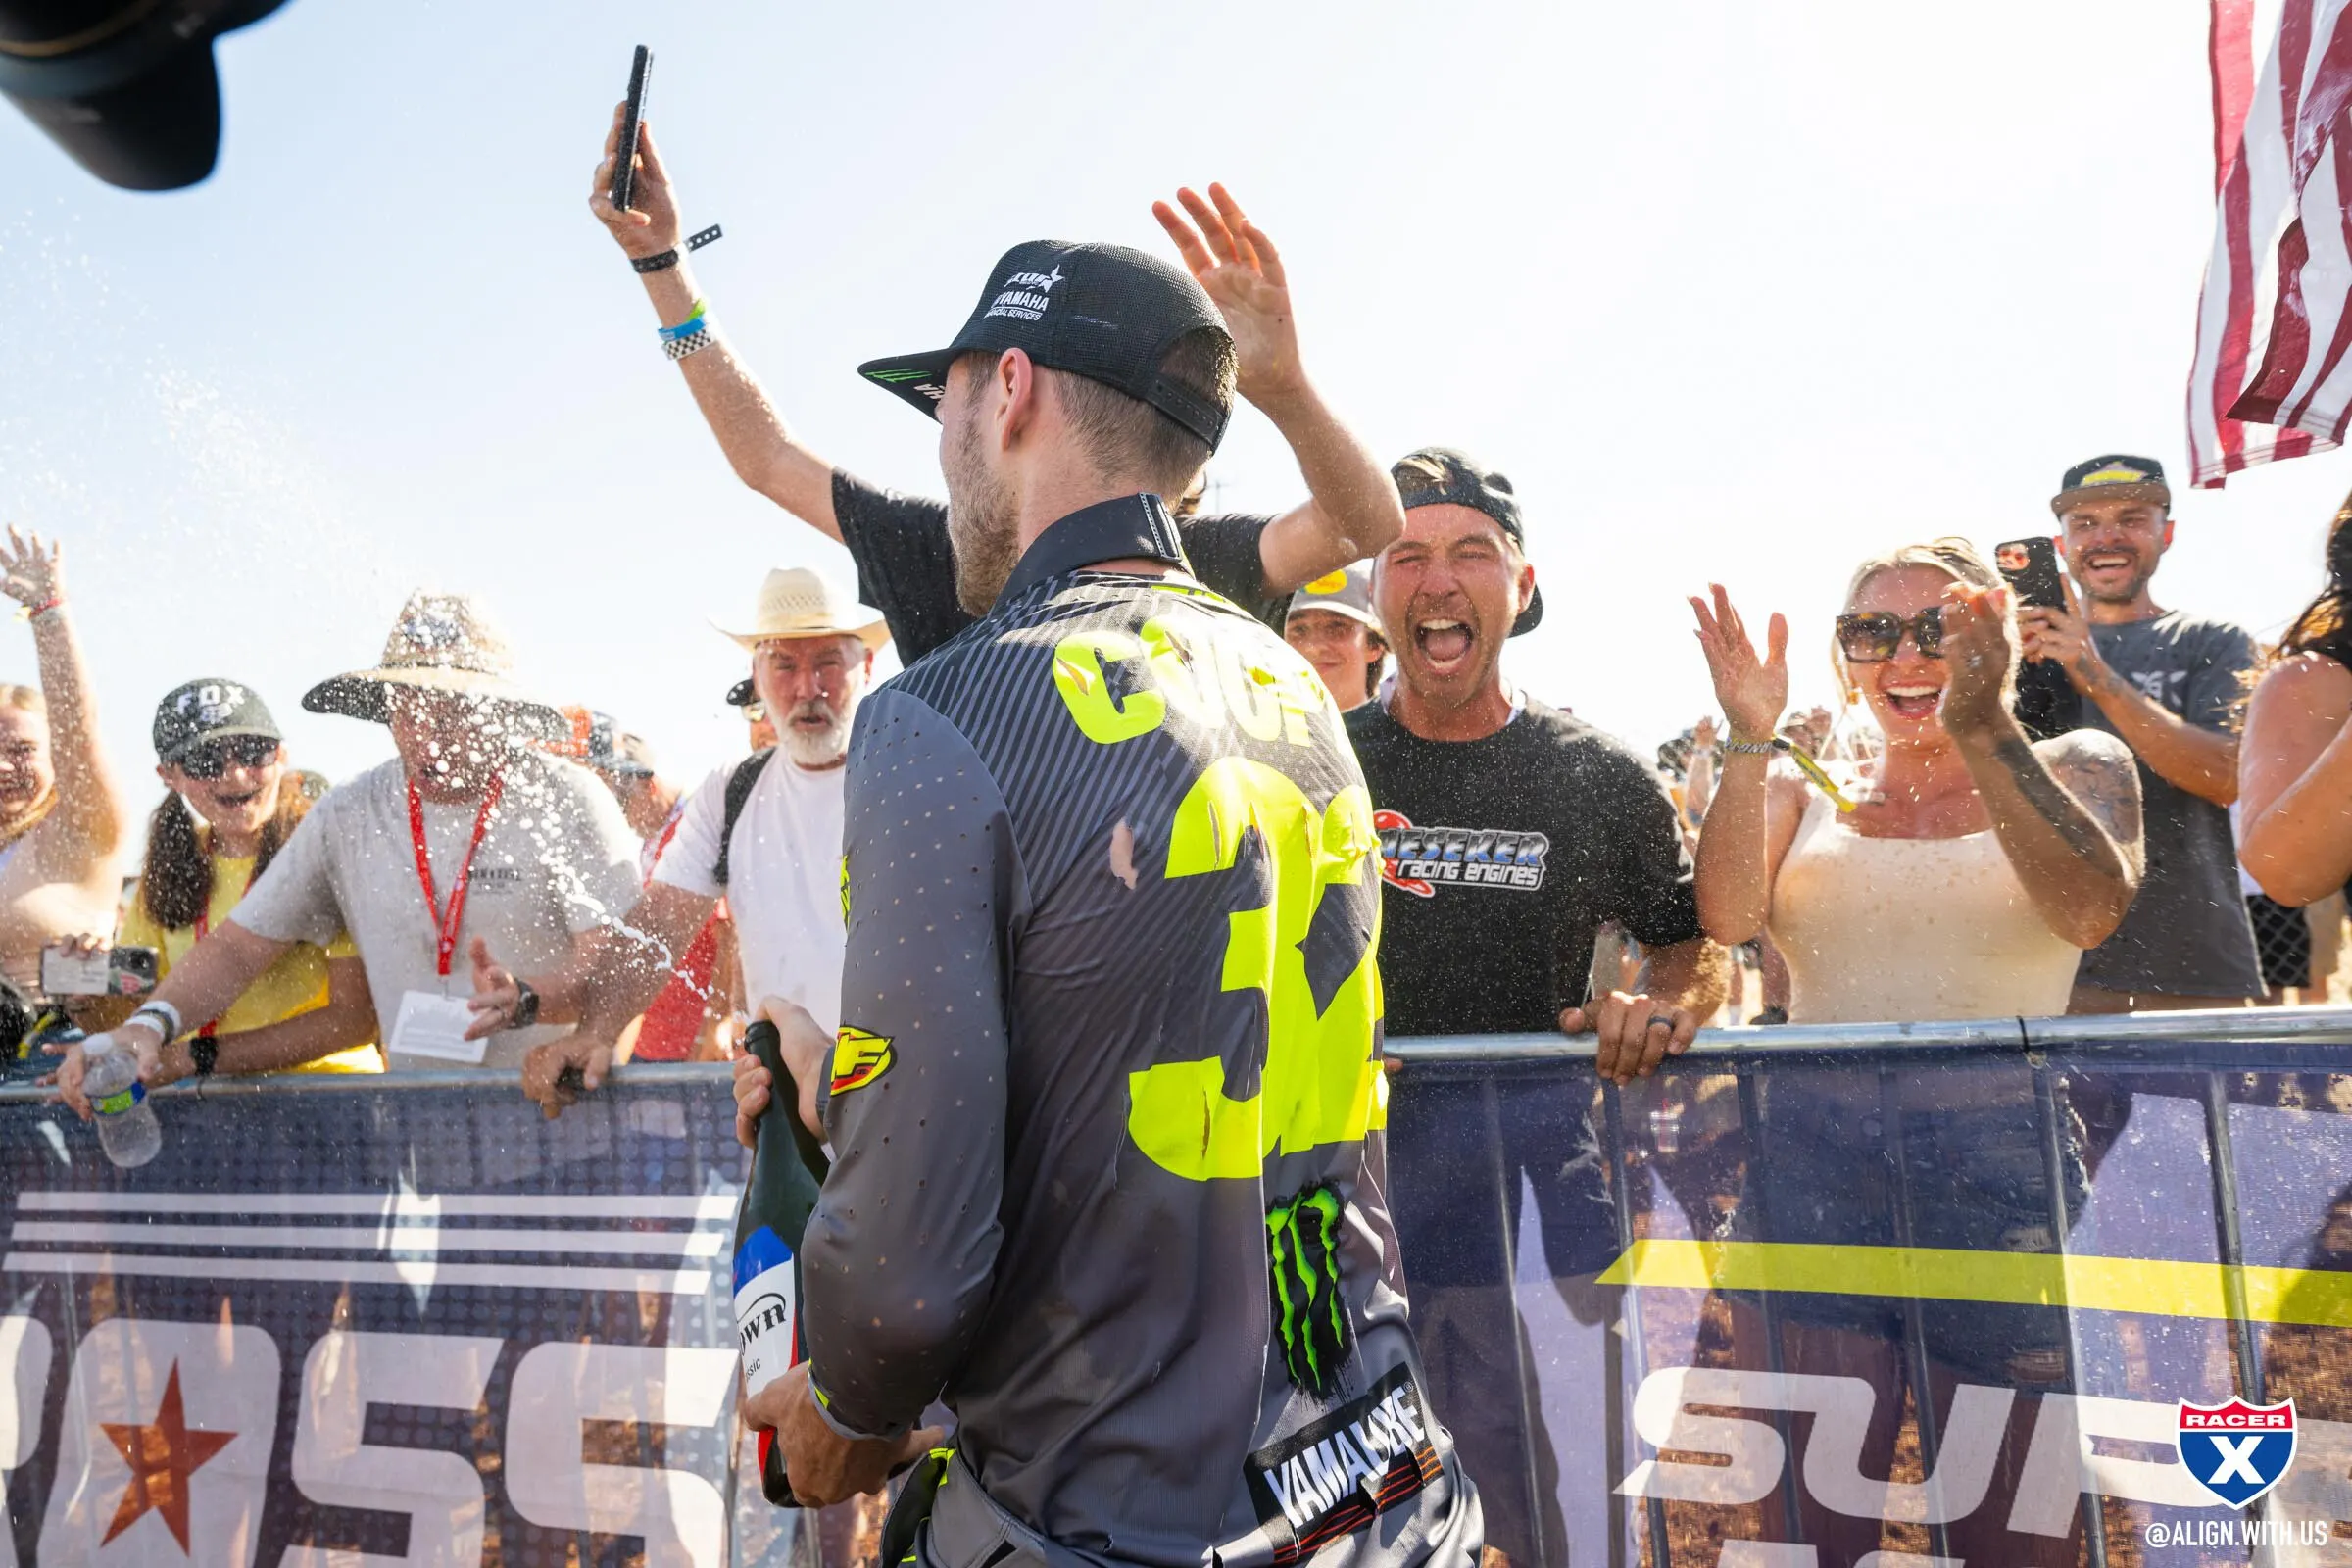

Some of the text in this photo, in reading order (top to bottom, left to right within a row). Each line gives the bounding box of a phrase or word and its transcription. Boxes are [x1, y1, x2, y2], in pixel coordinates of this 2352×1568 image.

[999, 291, 1050, 312] YAMAHA
[1007, 309, 1043, 321] SERVICES
[175, 685, 245, 715] FOX
